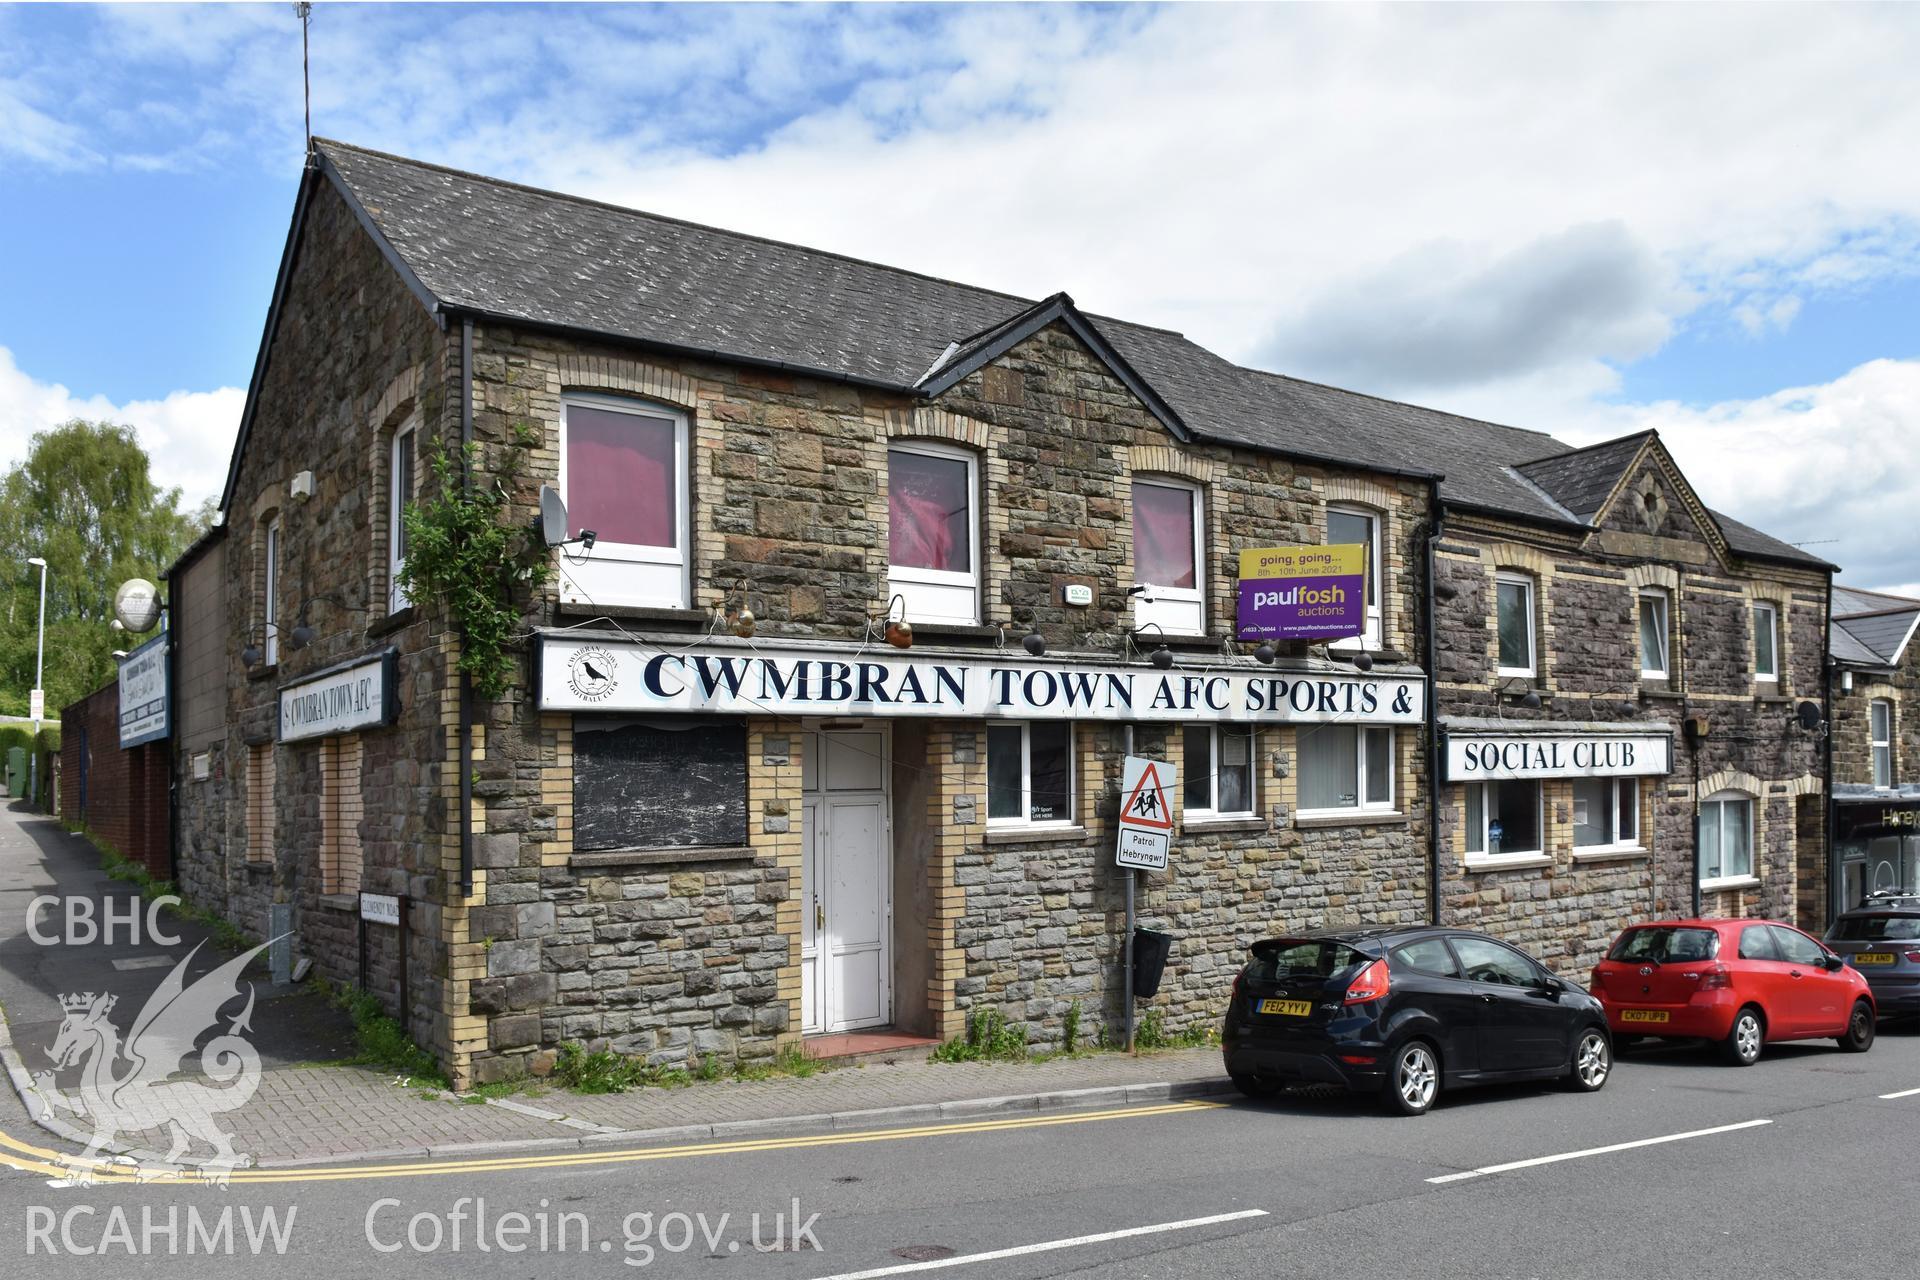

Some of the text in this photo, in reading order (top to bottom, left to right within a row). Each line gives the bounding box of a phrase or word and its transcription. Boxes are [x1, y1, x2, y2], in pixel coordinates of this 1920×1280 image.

[1260, 553, 1342, 567] going, going...
[1257, 568, 1271, 577] 8th
[1279, 568, 1297, 576] 10th
[1299, 566, 1320, 575] June
[1322, 565, 1343, 574] 2021
[1298, 605, 1345, 617] auctions
[1283, 623, 1357, 632] www.paulfoshauctions.com
[643, 653, 1413, 714] CWMBRAN TOWN AFC SPORTS &
[291, 677, 372, 727] CWMBRAN TOWN AFC
[1464, 741, 1635, 771] SOCIAL CLUB
[1132, 835, 1155, 847] Patrol
[1122, 848, 1162, 863] Hebryngwr
[1264, 1000, 1286, 1012] FE12
[1287, 1002, 1308, 1014] YYV
